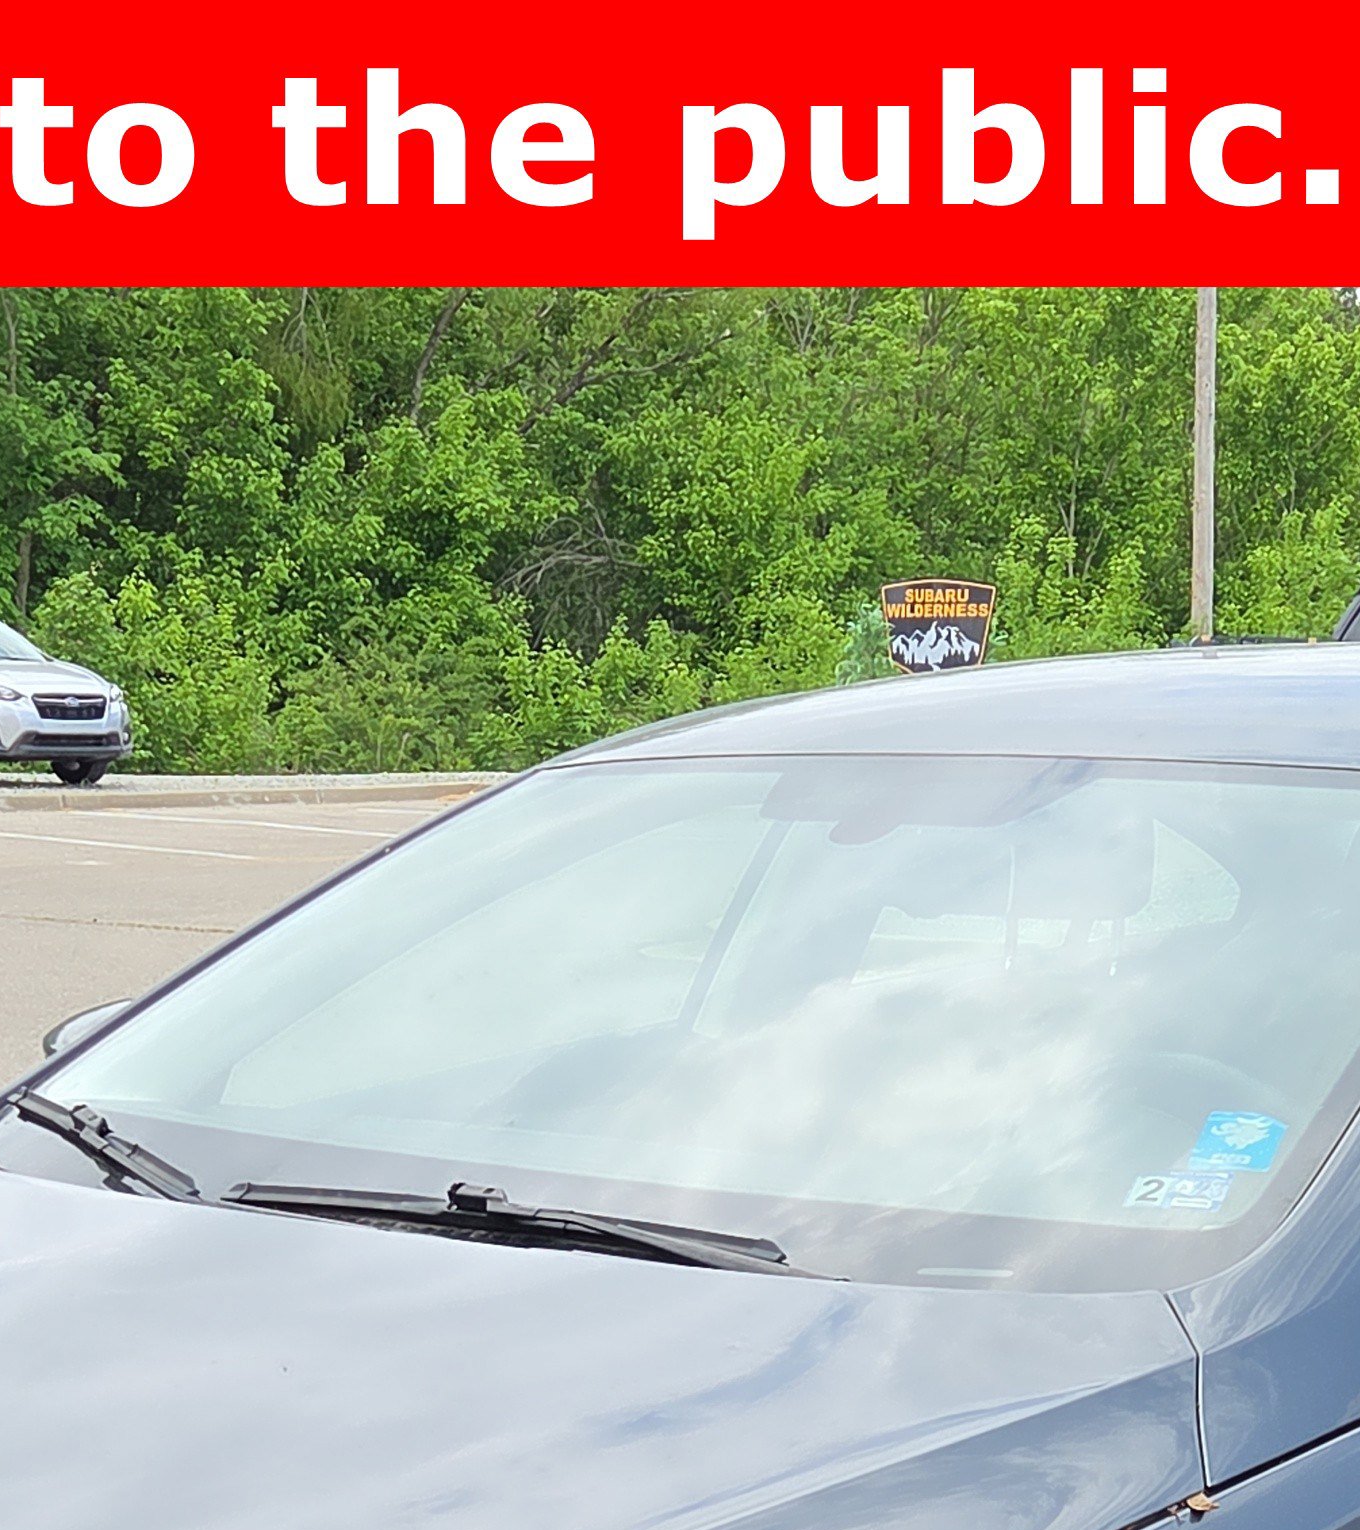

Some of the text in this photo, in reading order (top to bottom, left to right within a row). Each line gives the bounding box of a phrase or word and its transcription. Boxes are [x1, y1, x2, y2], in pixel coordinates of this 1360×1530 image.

[904, 588, 970, 603] SUBARU
[886, 603, 989, 618] WILDERNESS
[1134, 1178, 1165, 1202] 2
